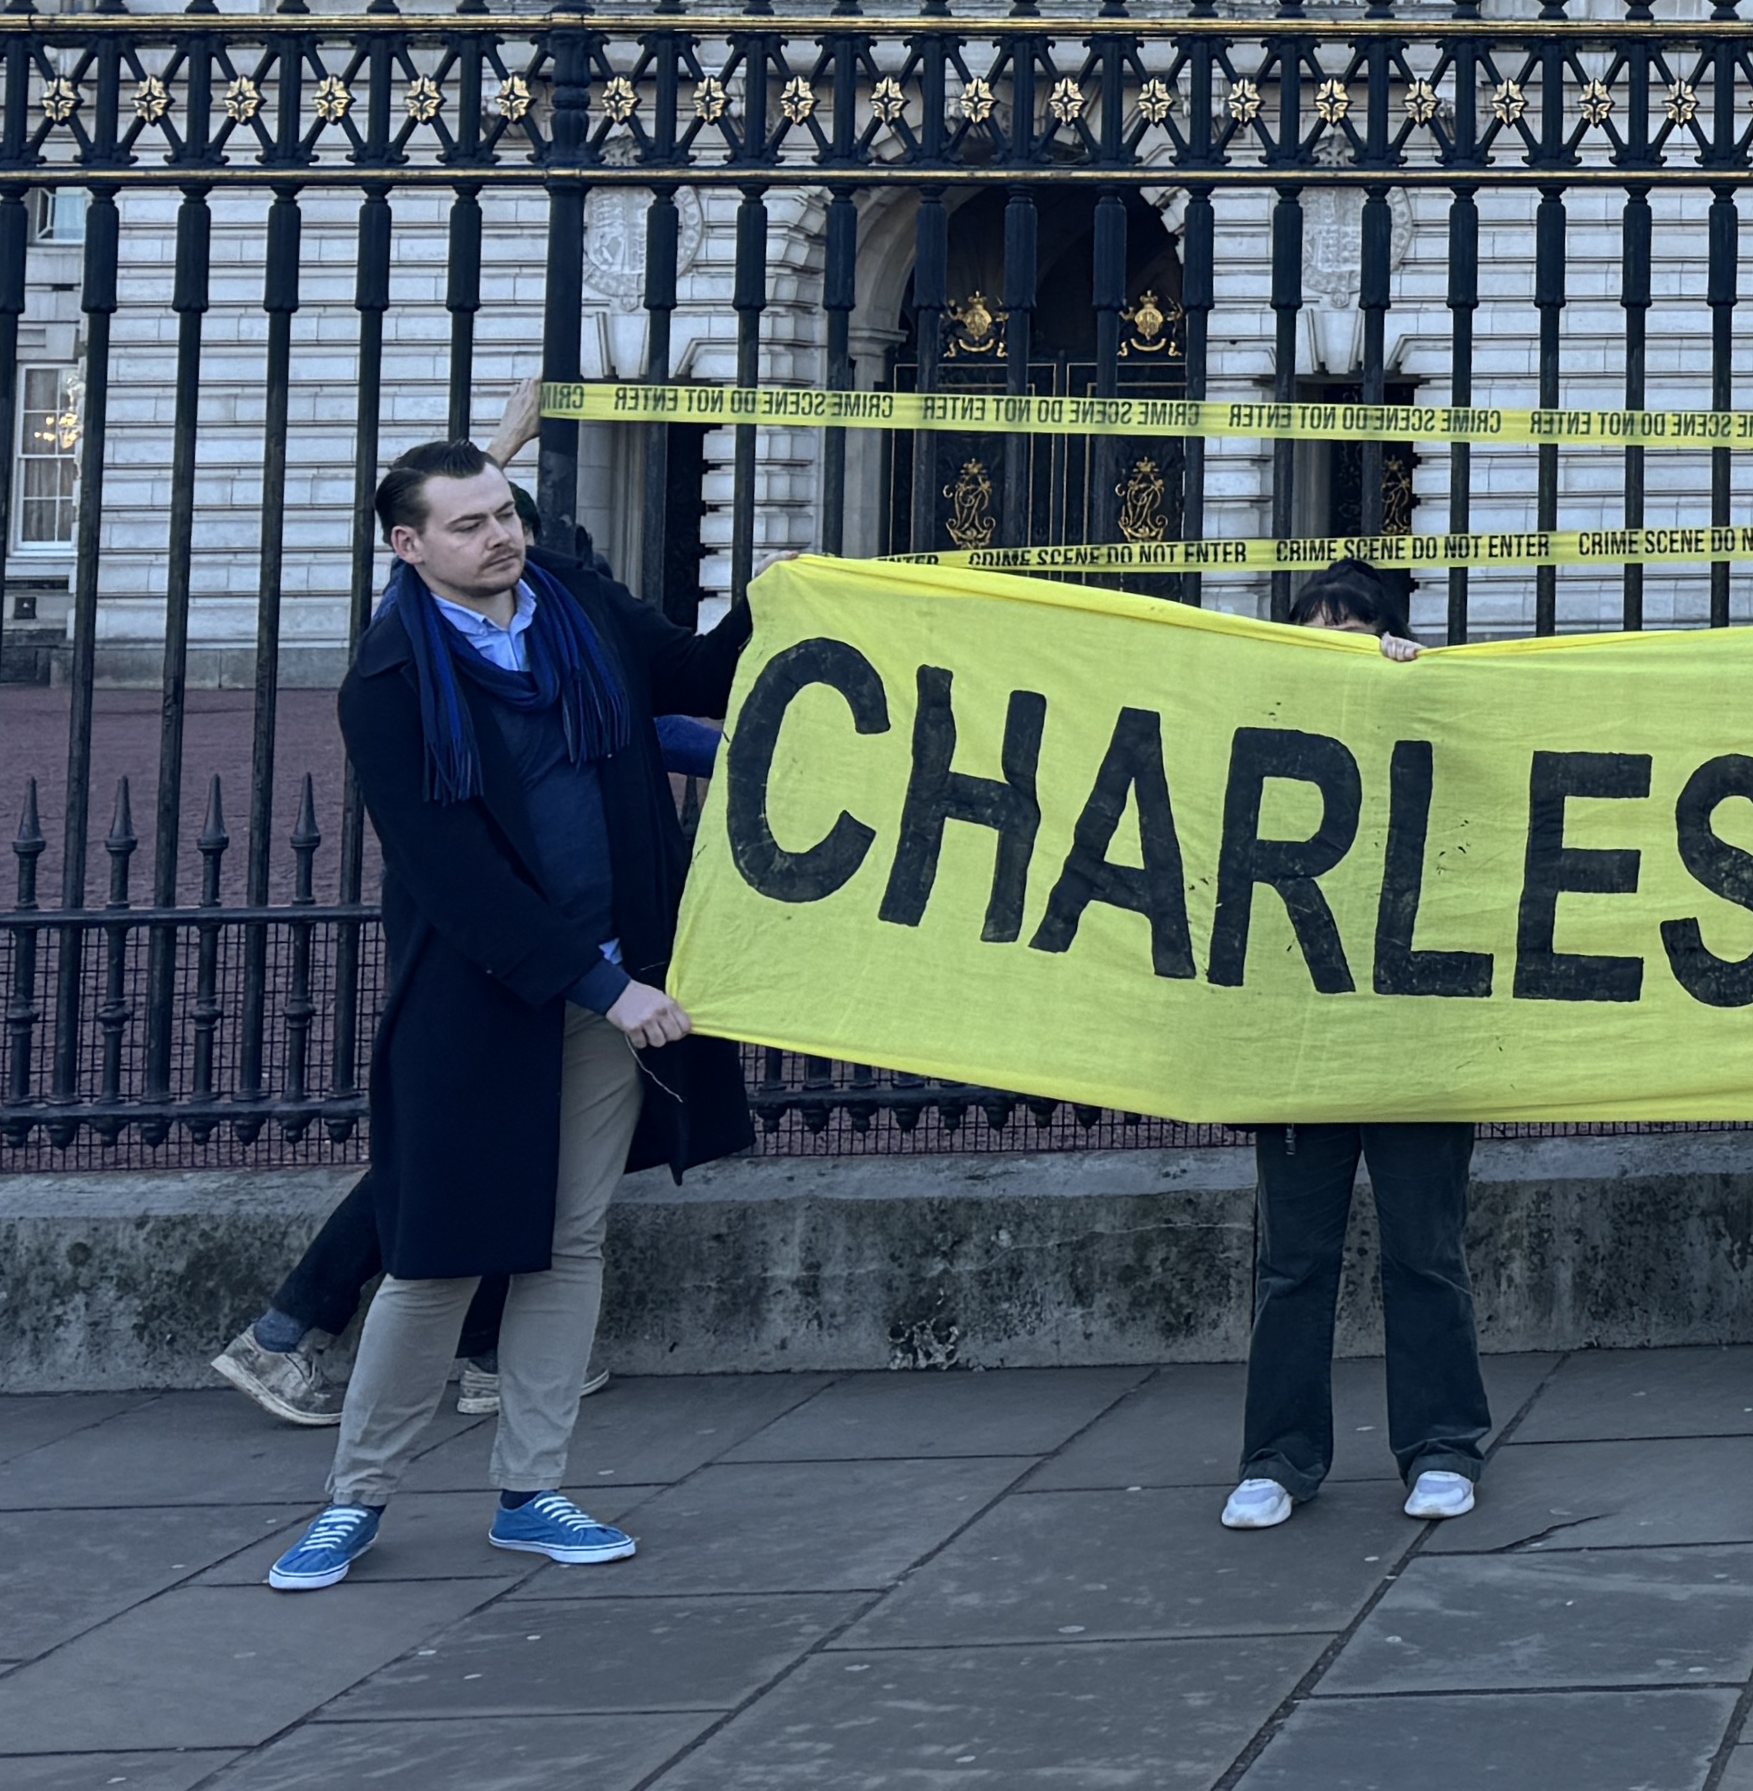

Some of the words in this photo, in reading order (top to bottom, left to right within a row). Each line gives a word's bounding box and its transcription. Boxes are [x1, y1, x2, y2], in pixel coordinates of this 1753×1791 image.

[1107, 546, 1132, 563] DO
[1140, 544, 1178, 562] NOT
[1185, 542, 1246, 563] ENTER
[1277, 540, 1337, 561] CRIME
[1344, 539, 1404, 560] SCENE
[1412, 538, 1437, 559] DO
[1444, 536, 1482, 559] NOT
[1489, 534, 1549, 557] ENTER
[1579, 532, 1639, 555] CRIME
[1645, 530, 1704, 553] SCENE
[1712, 529, 1736, 552] DO
